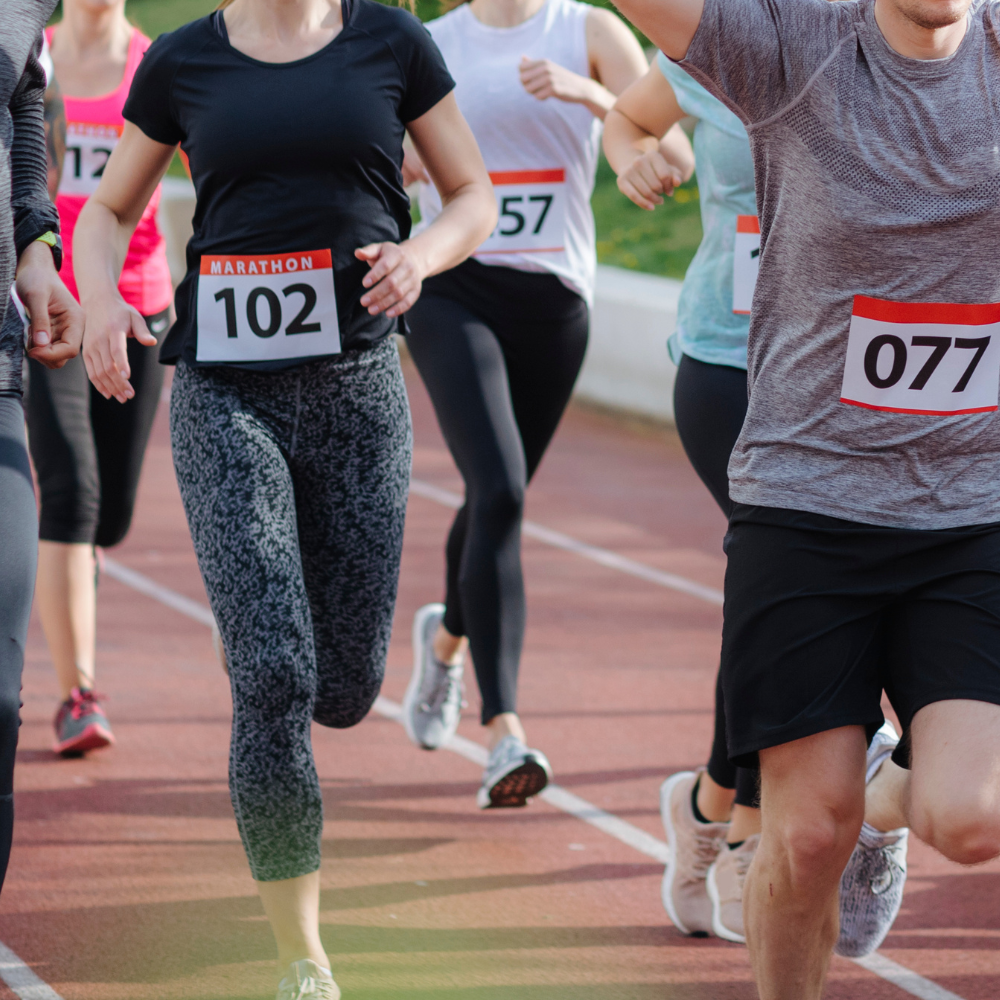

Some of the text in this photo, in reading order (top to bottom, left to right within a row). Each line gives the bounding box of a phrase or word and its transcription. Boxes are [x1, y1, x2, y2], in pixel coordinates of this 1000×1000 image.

[490, 194, 554, 237] 57
[210, 256, 313, 275] MARATHON
[214, 282, 322, 339] 102
[863, 333, 992, 393] 077
